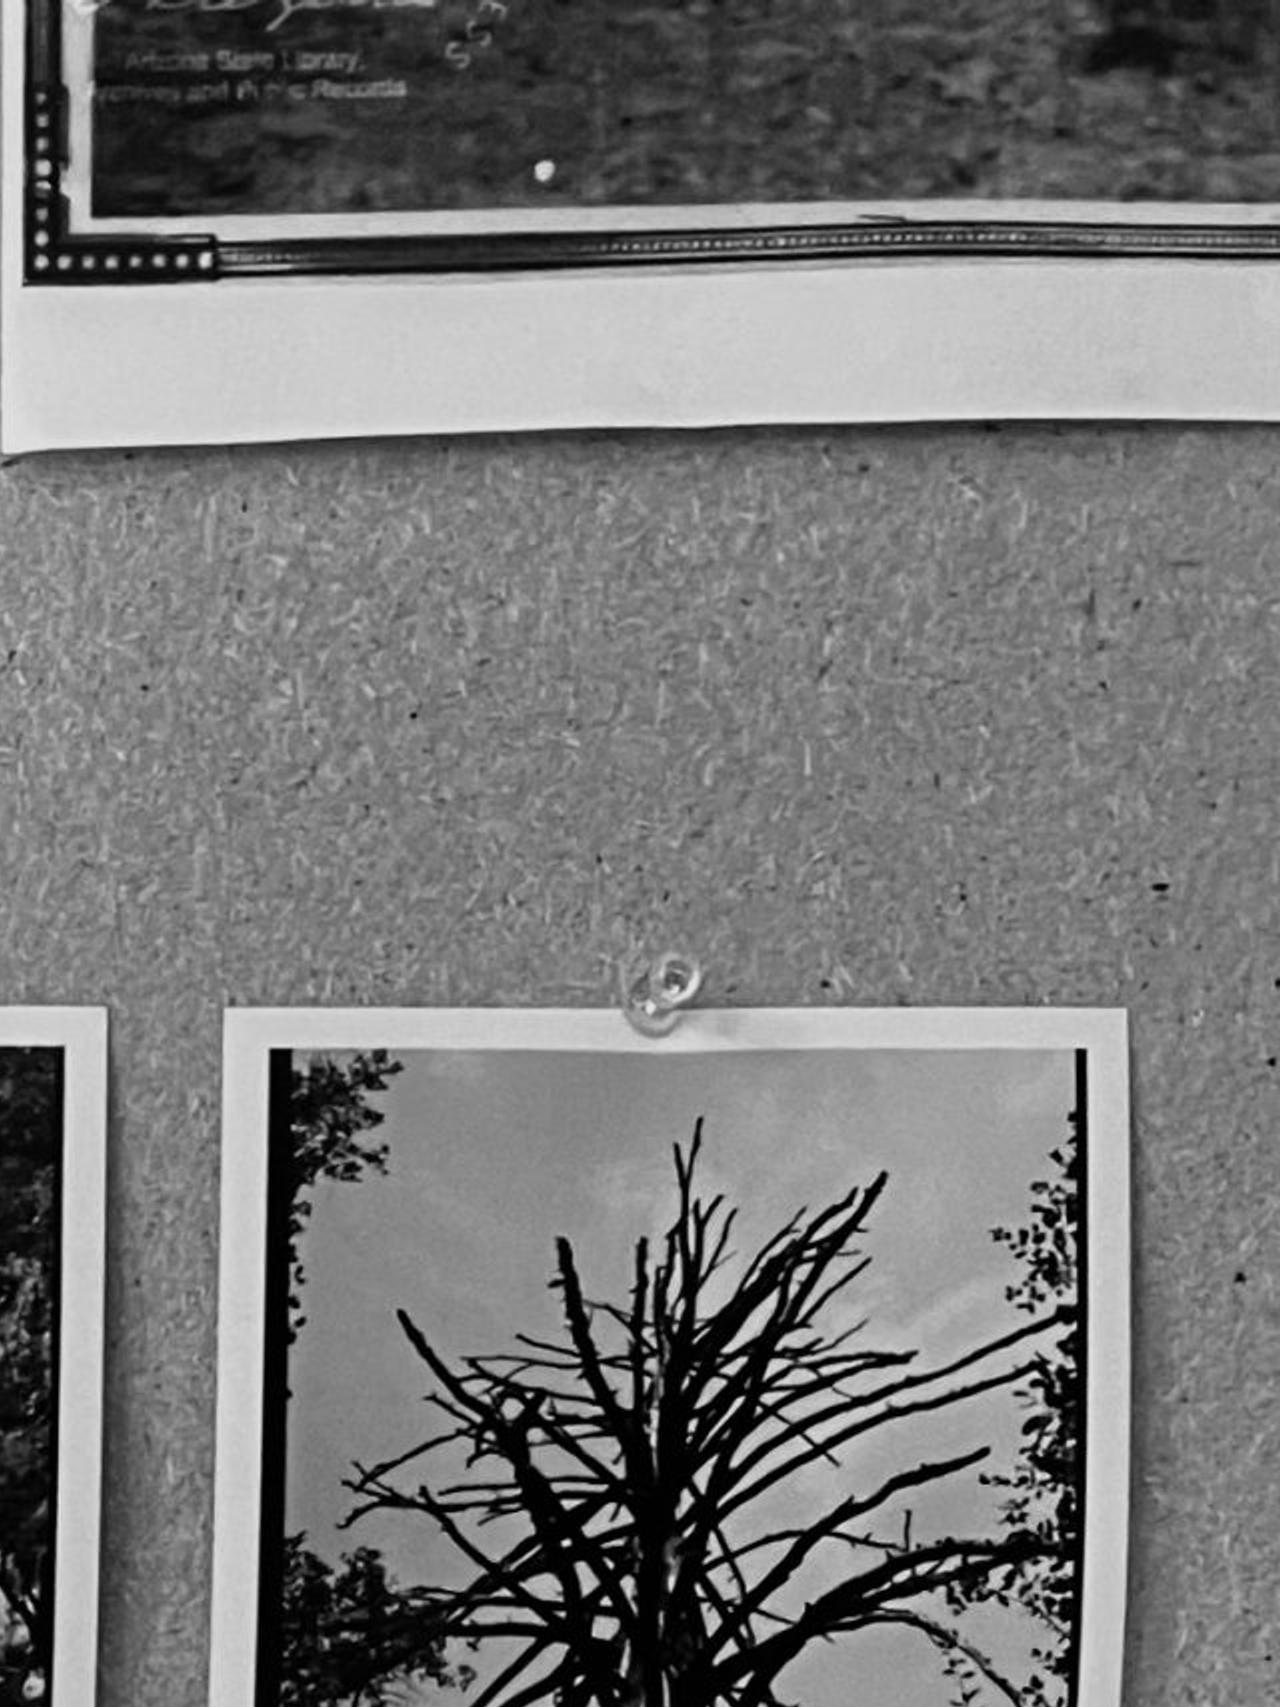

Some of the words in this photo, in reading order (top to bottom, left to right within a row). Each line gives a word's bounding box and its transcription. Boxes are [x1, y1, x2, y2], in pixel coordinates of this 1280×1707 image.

[215, 49, 274, 72] State
[185, 80, 229, 102] and
[310, 78, 408, 100] Records
